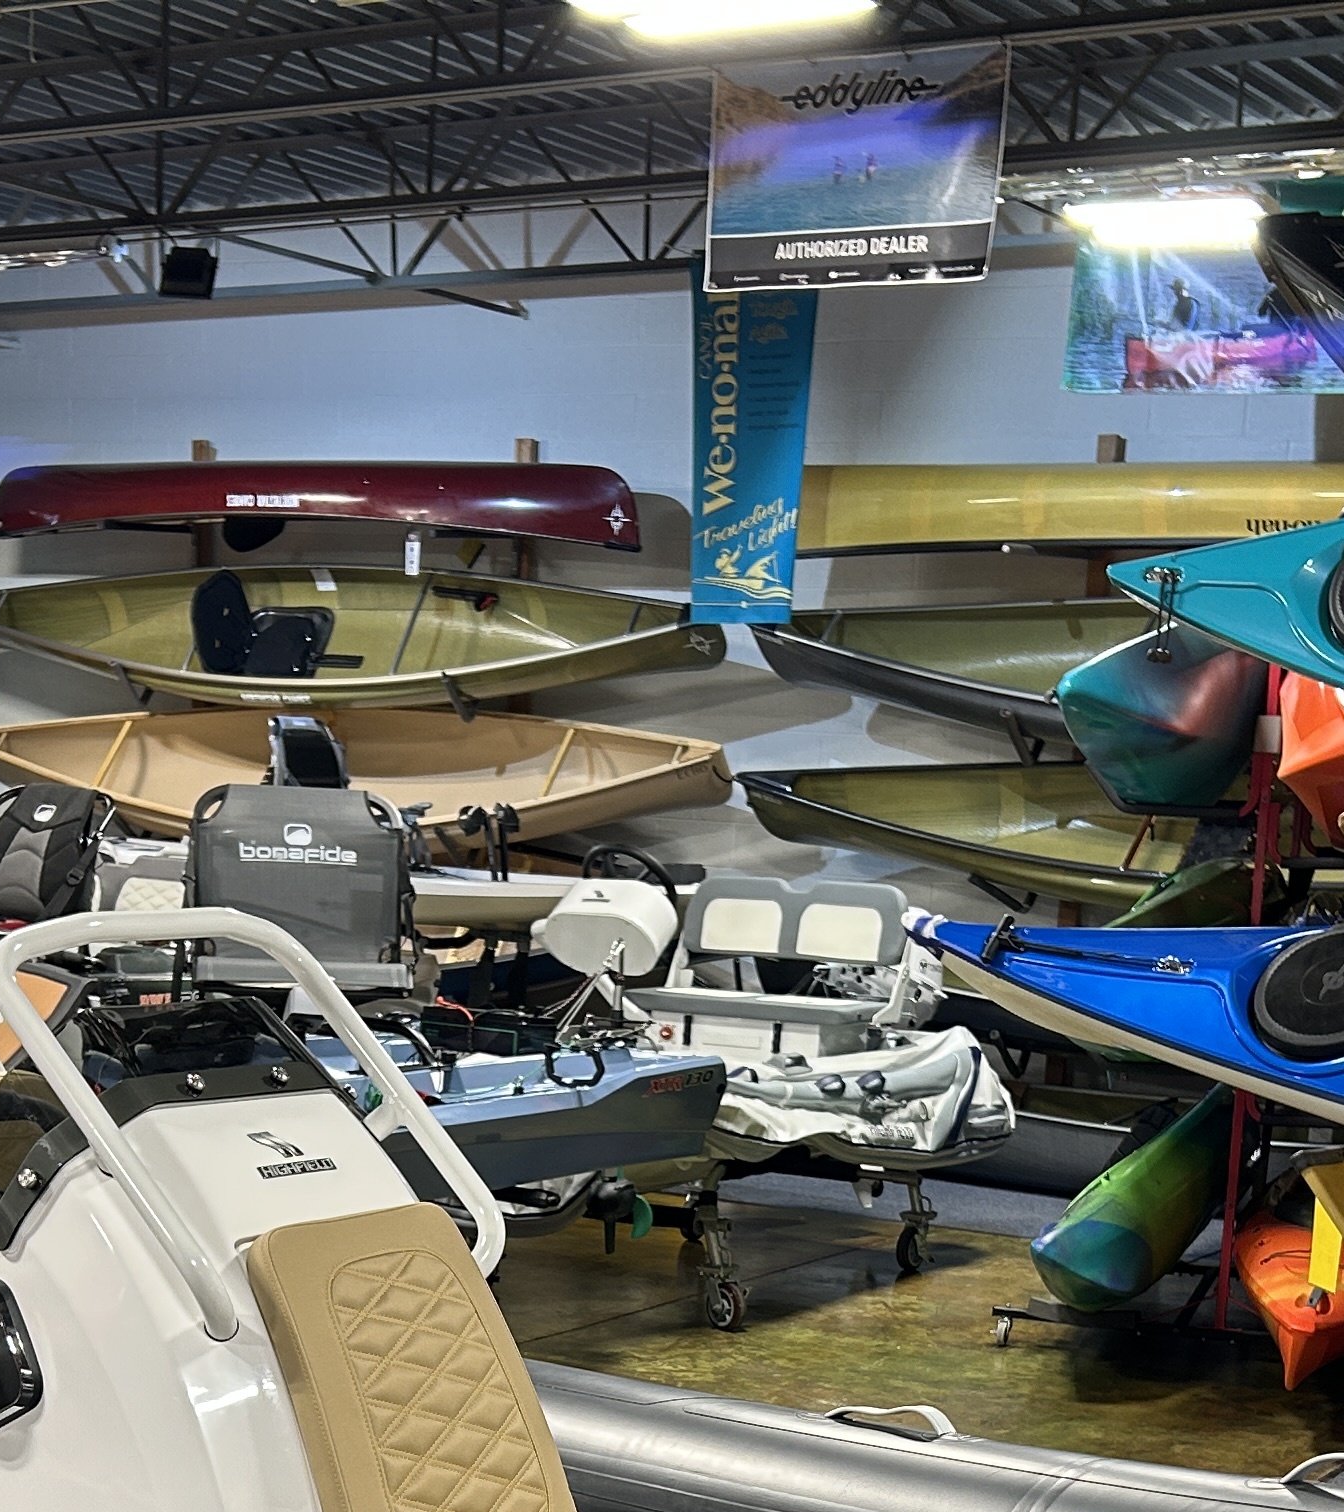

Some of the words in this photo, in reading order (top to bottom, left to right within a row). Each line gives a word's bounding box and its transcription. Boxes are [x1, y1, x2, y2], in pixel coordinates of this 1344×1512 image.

[781, 68, 942, 117] eddyline
[774, 238, 868, 261] AUTHORIZED
[869, 234, 929, 256] DEALER
[239, 842, 358, 864] bonafide
[258, 1158, 336, 1179] HIGHFIELD
